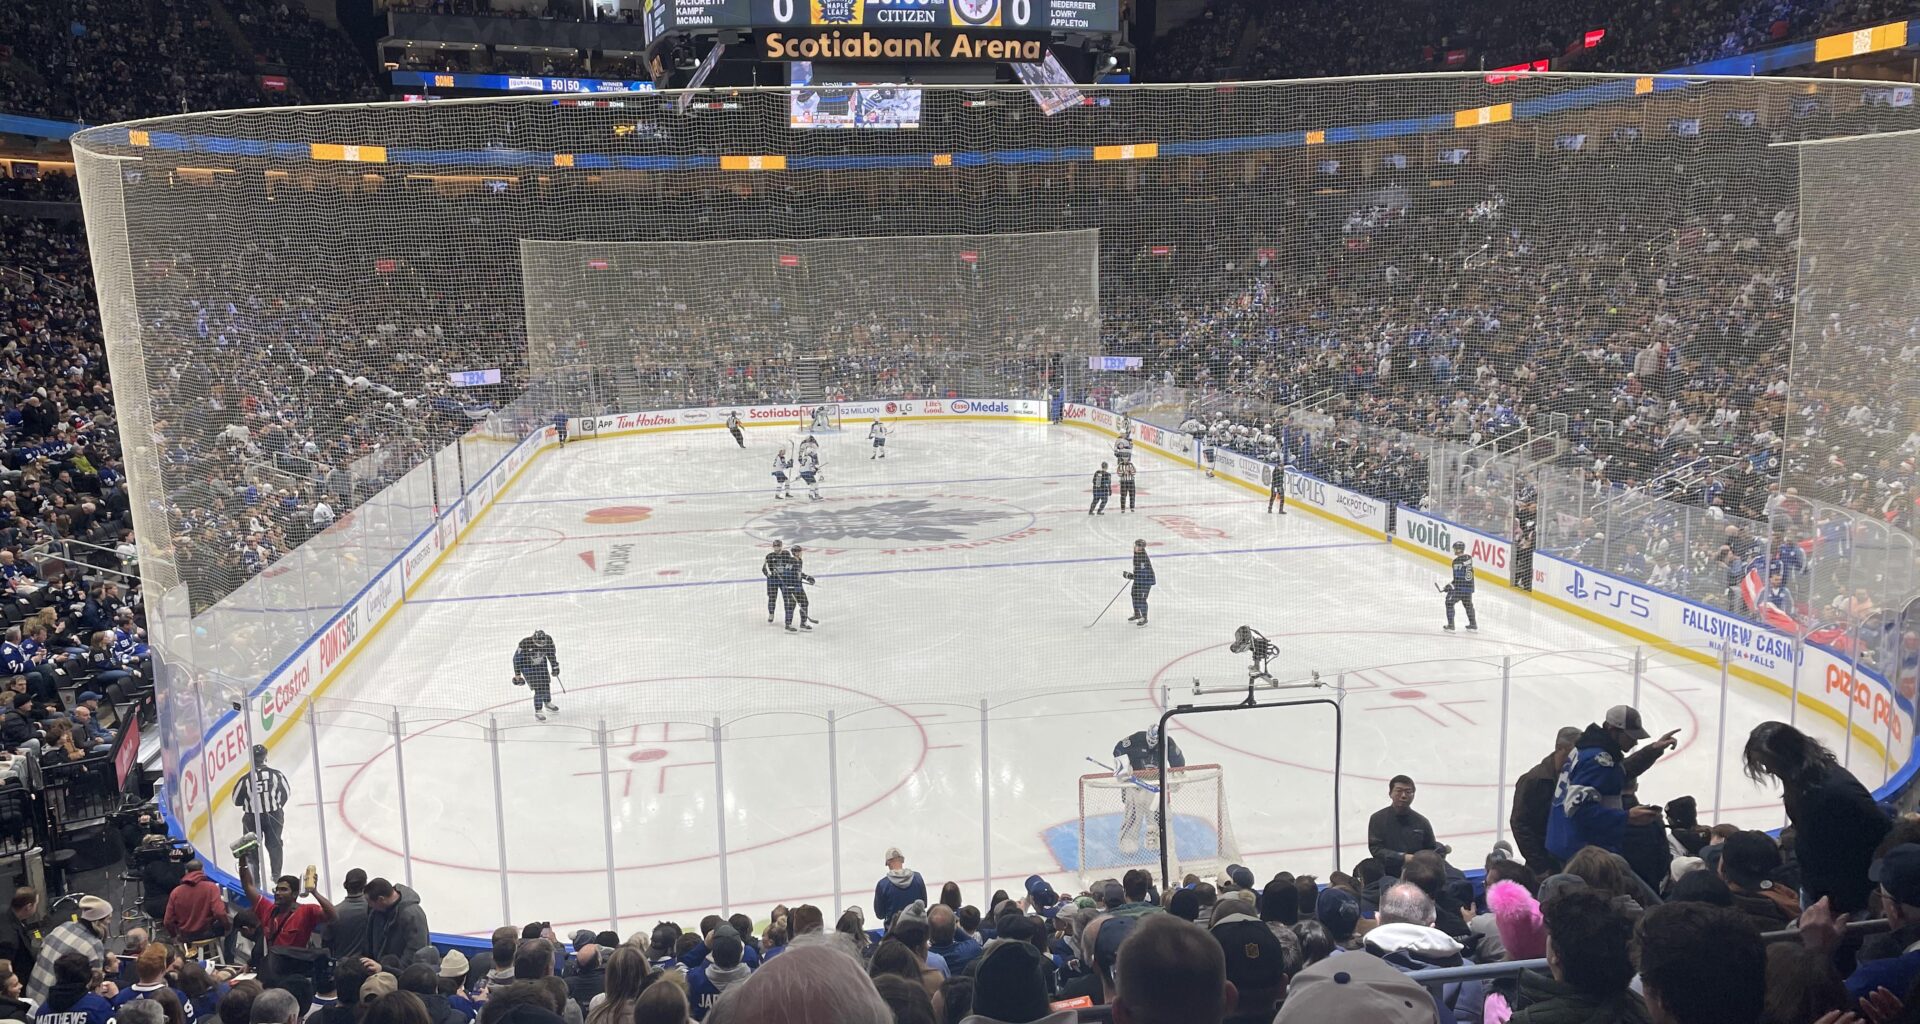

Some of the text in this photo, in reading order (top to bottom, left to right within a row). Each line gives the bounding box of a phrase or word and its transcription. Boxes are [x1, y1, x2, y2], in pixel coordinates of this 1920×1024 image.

[676, 7, 705, 16] KAMPF
[877, 10, 936, 22] CITIZEN
[1050, 10, 1077, 18] LOWRY
[676, 16, 713, 25] MCMANN
[1050, 19, 1089, 28] APPLETON
[766, 30, 1041, 59] Scotiabank Arena
[435, 74, 455, 88] SOME
[1103, 357, 1127, 369] IBM
[462, 371, 486, 384] IBM
[750, 406, 814, 419] Scotiabank
[850, 406, 880, 415] MILLION
[899, 403, 913, 412] LG
[971, 401, 1009, 413] Medals
[616, 412, 677, 430] Tim Hortons
[1335, 492, 1377, 516] JACKPOT CITY
[1407, 519, 1451, 553] voilà
[1471, 538, 1506, 569] AVIS
[1594, 581, 1650, 619] PS5
[1682, 607, 1753, 646] FALLSVIEW
[319, 605, 359, 675] POINTSBET
[1749, 653, 1775, 669] FALLS
[274, 659, 310, 713] Castrol
[1873, 692, 1902, 744] piza
[256, 780, 269, 793] 51
[35, 1011, 88, 1024] MATTHEWS
